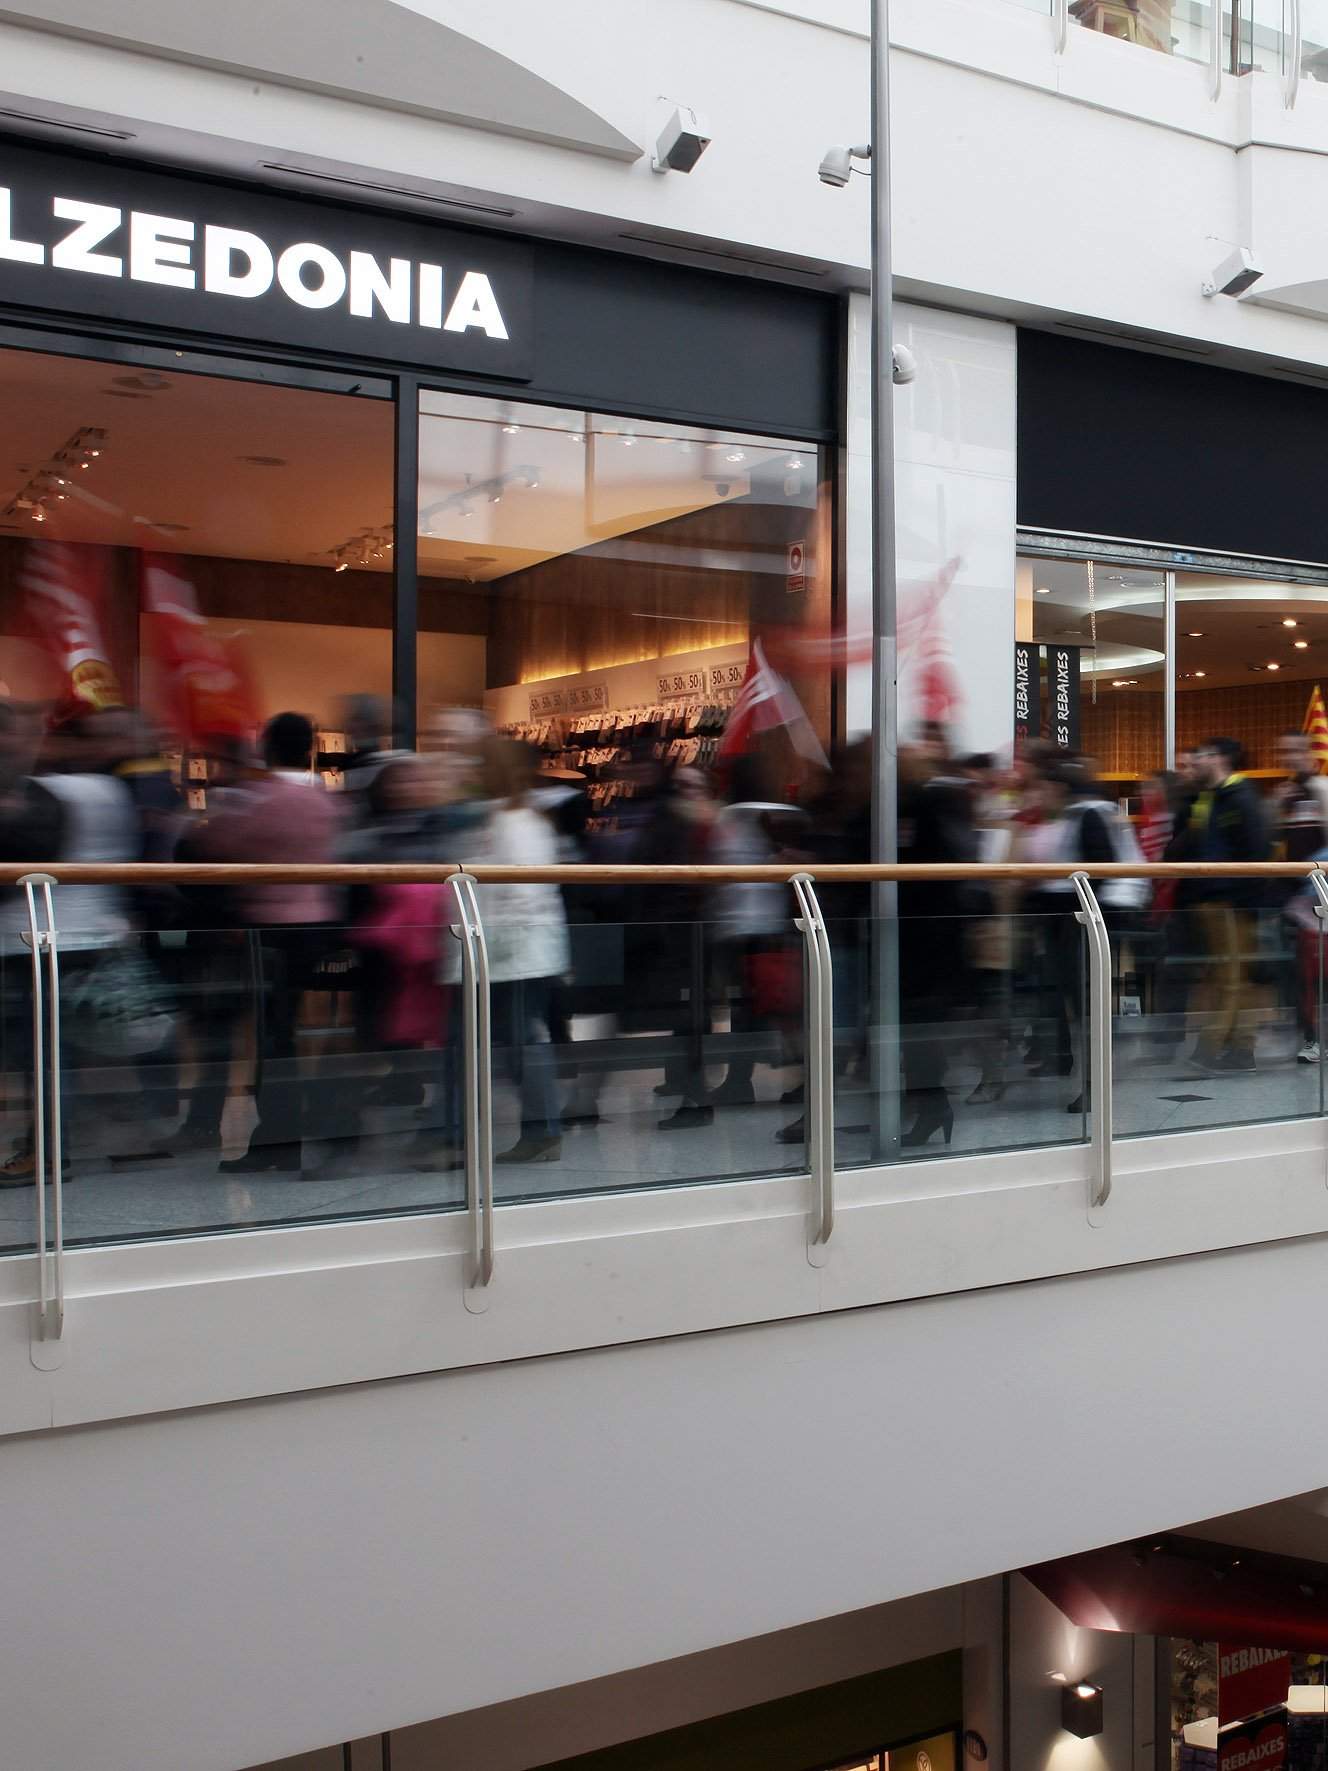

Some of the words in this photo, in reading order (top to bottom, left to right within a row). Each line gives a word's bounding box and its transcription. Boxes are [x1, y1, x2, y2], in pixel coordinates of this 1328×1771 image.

[0, 186, 510, 340] LZEDONIA
[1016, 648, 1029, 719] REBAIXES
[1057, 651, 1070, 720] REBAIXES
[1221, 1736, 1285, 1771] REBAIXES
